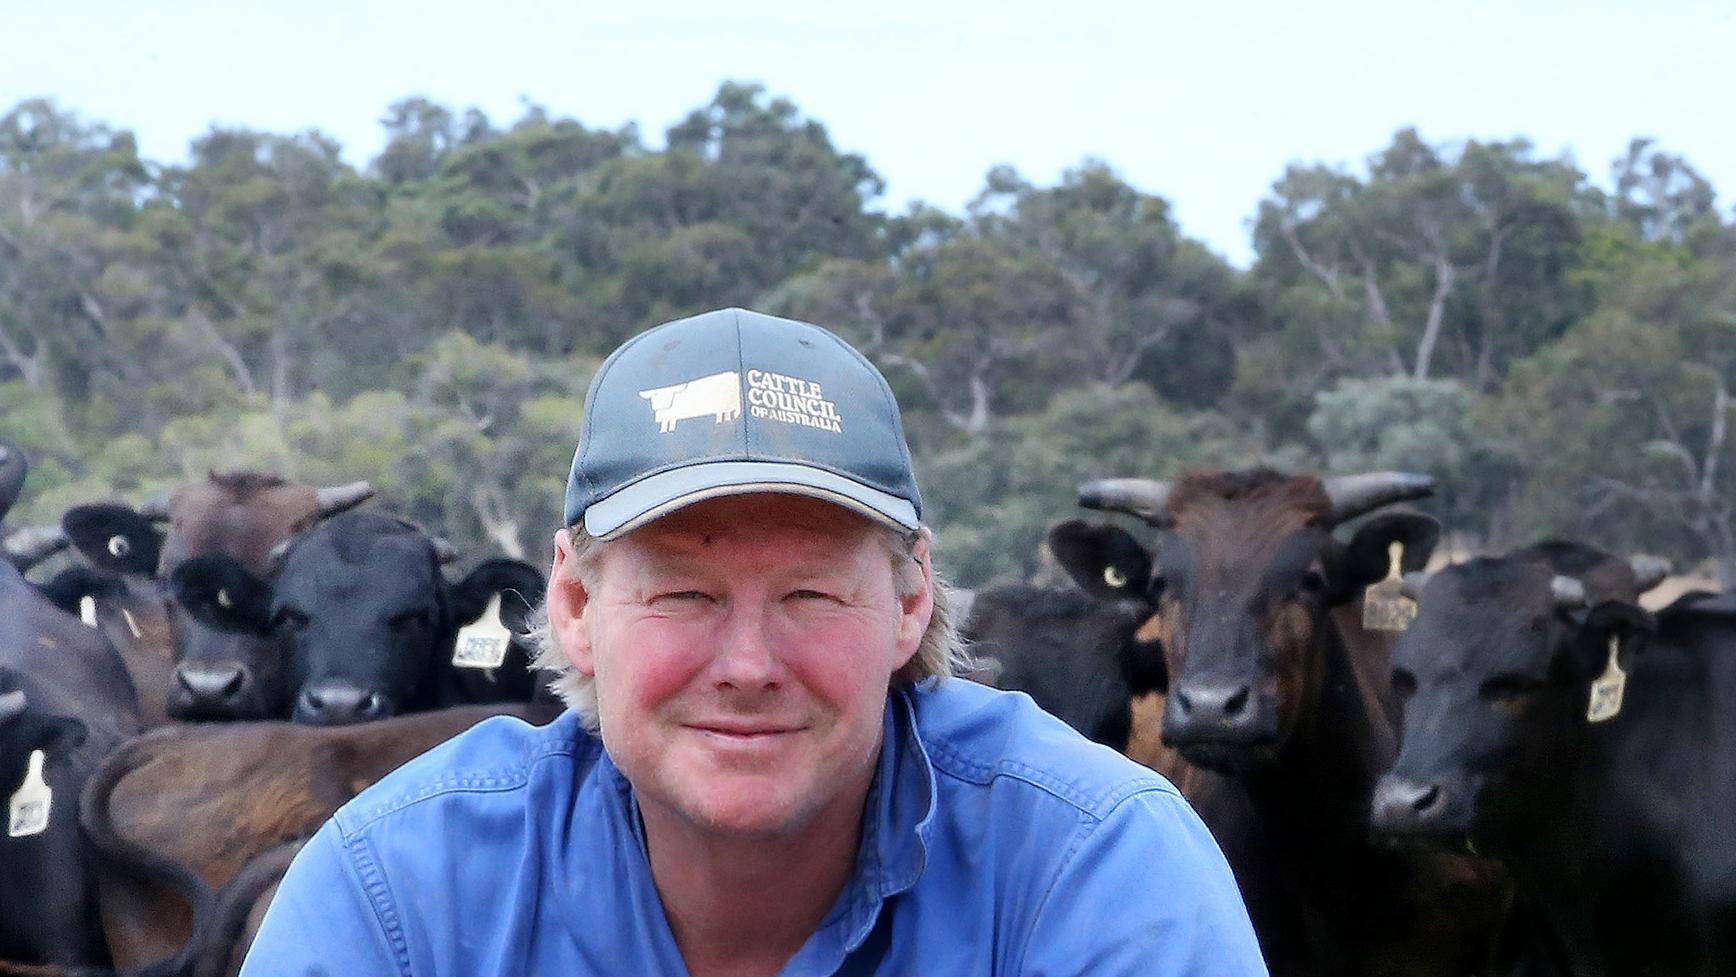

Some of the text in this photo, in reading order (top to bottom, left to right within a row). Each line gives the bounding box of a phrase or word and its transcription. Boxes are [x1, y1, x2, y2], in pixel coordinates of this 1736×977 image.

[747, 368, 823, 400] CATTLE
[747, 388, 842, 423] COUNCIL
[750, 405, 842, 433] OF AUSTRALIA
